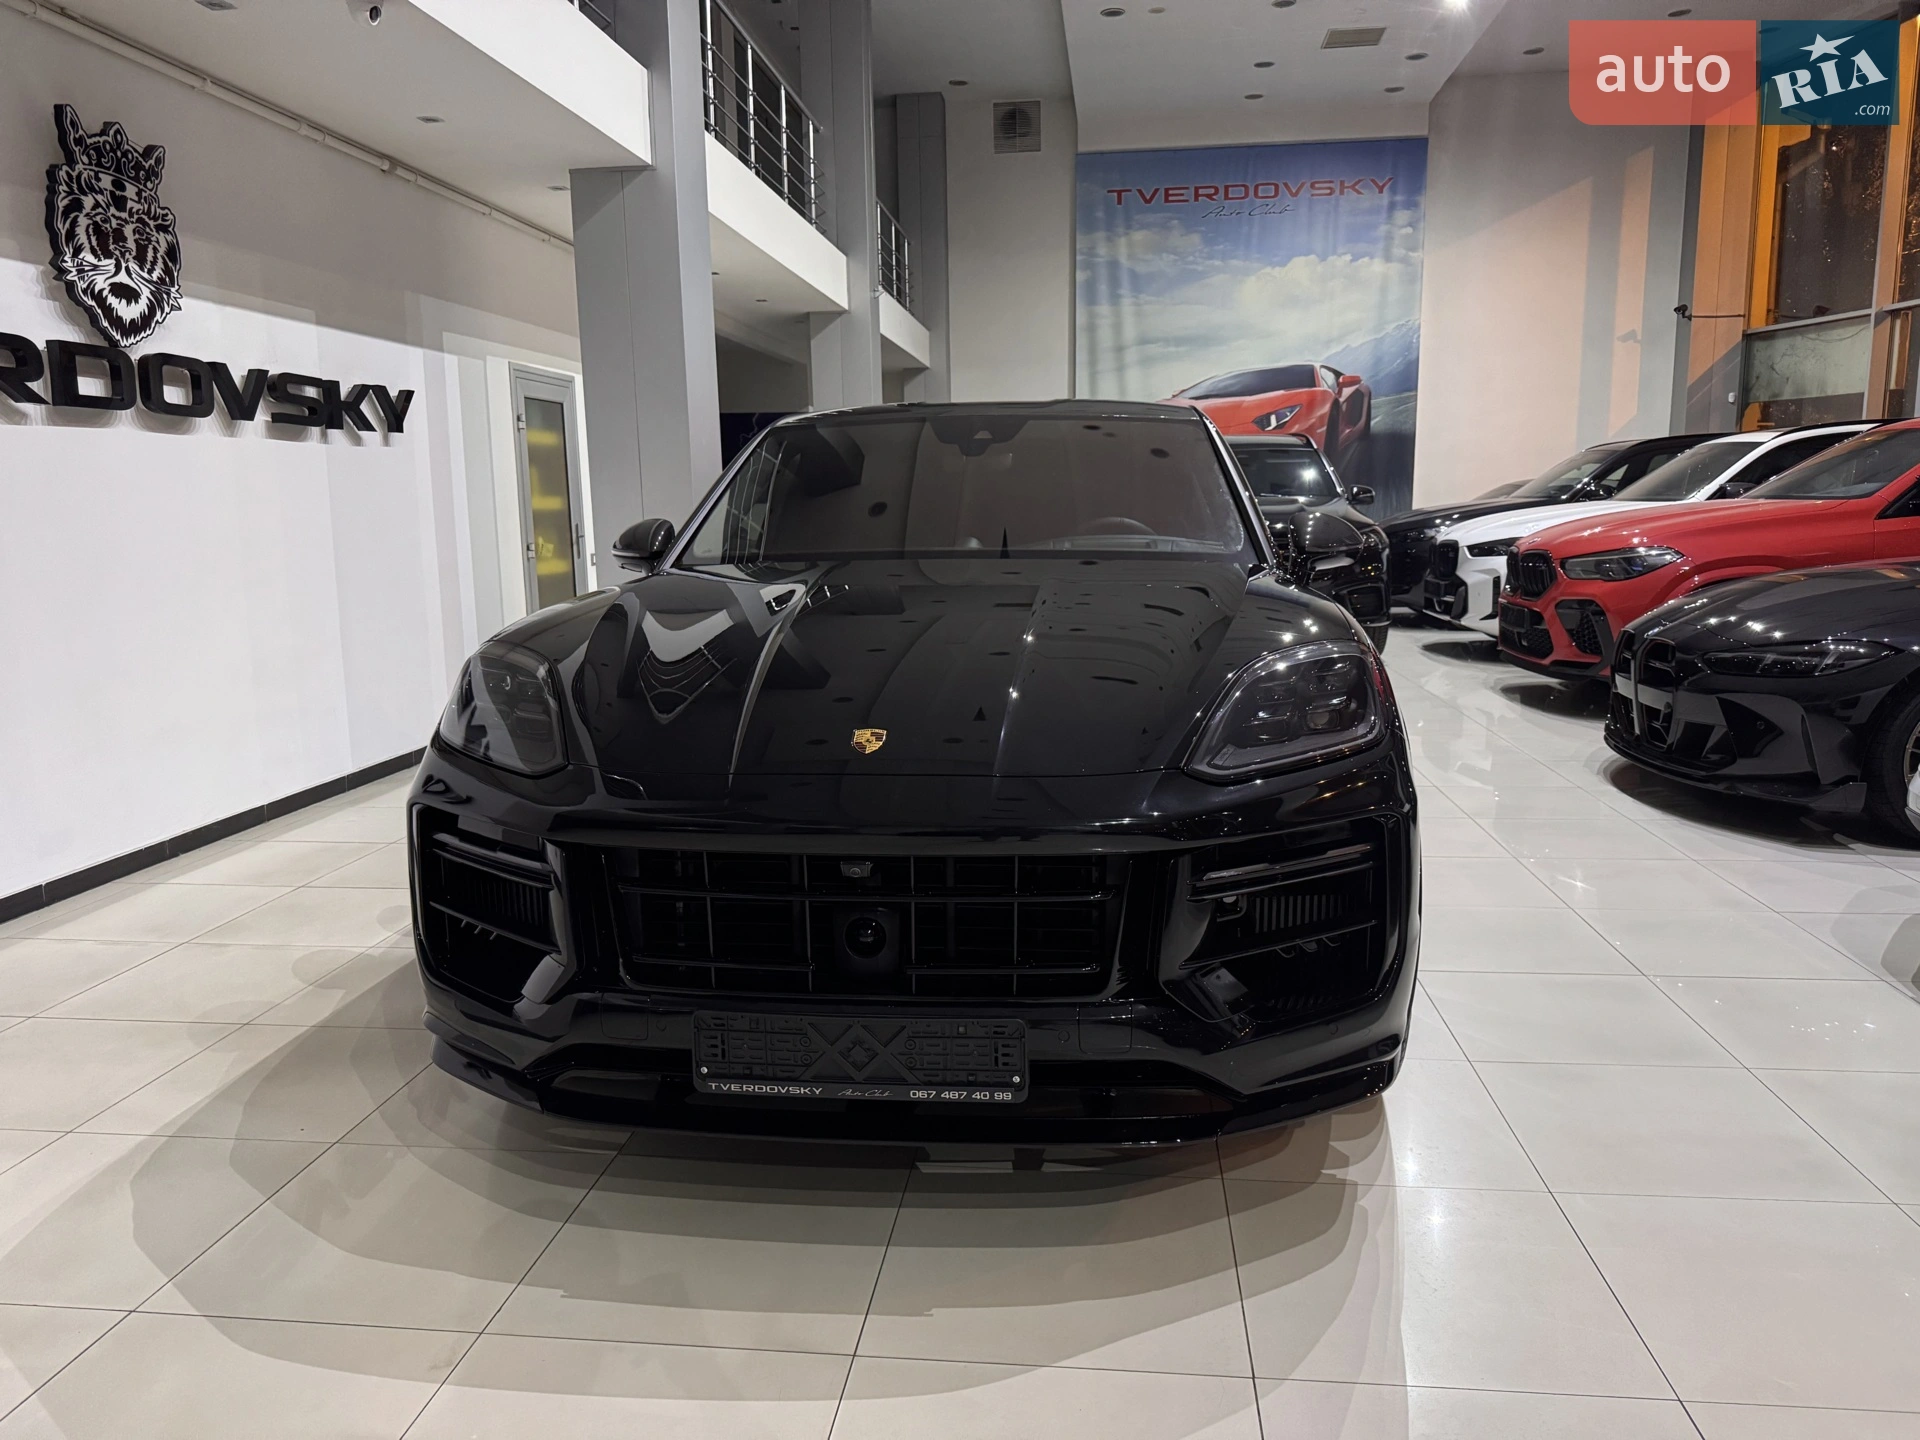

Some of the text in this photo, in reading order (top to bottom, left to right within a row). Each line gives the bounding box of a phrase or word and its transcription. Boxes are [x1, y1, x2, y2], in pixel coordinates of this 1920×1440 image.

[1107, 177, 1395, 206] TVERDOVSKY
[1201, 203, 1296, 219] Auto Club
[708, 1082, 1012, 1100] TVERDOVSKY Auto Club 067 487 40 99
